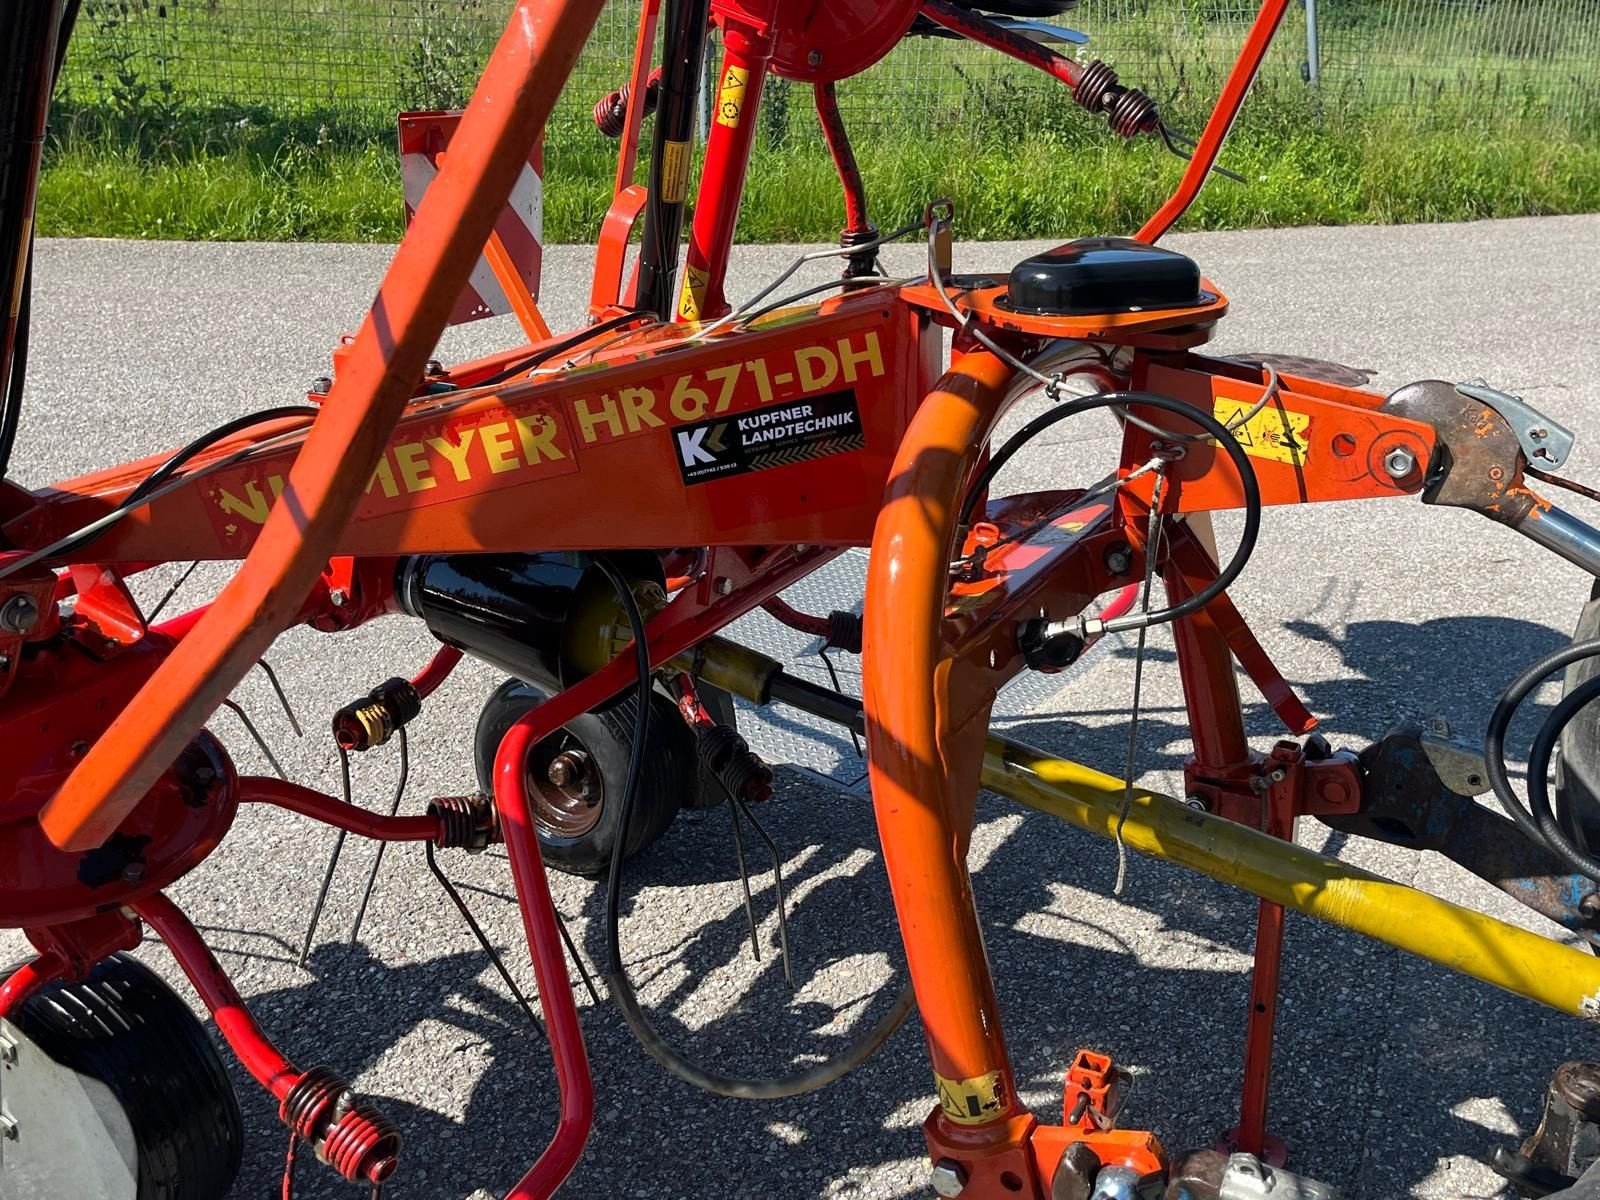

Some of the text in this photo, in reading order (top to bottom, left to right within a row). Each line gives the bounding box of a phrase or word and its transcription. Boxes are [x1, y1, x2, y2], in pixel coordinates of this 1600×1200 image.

[212, 331, 885, 536] NMEYER HR 671-DH
[737, 405, 813, 431] KUPFNER
[741, 411, 854, 446] LANDTECHNIK
